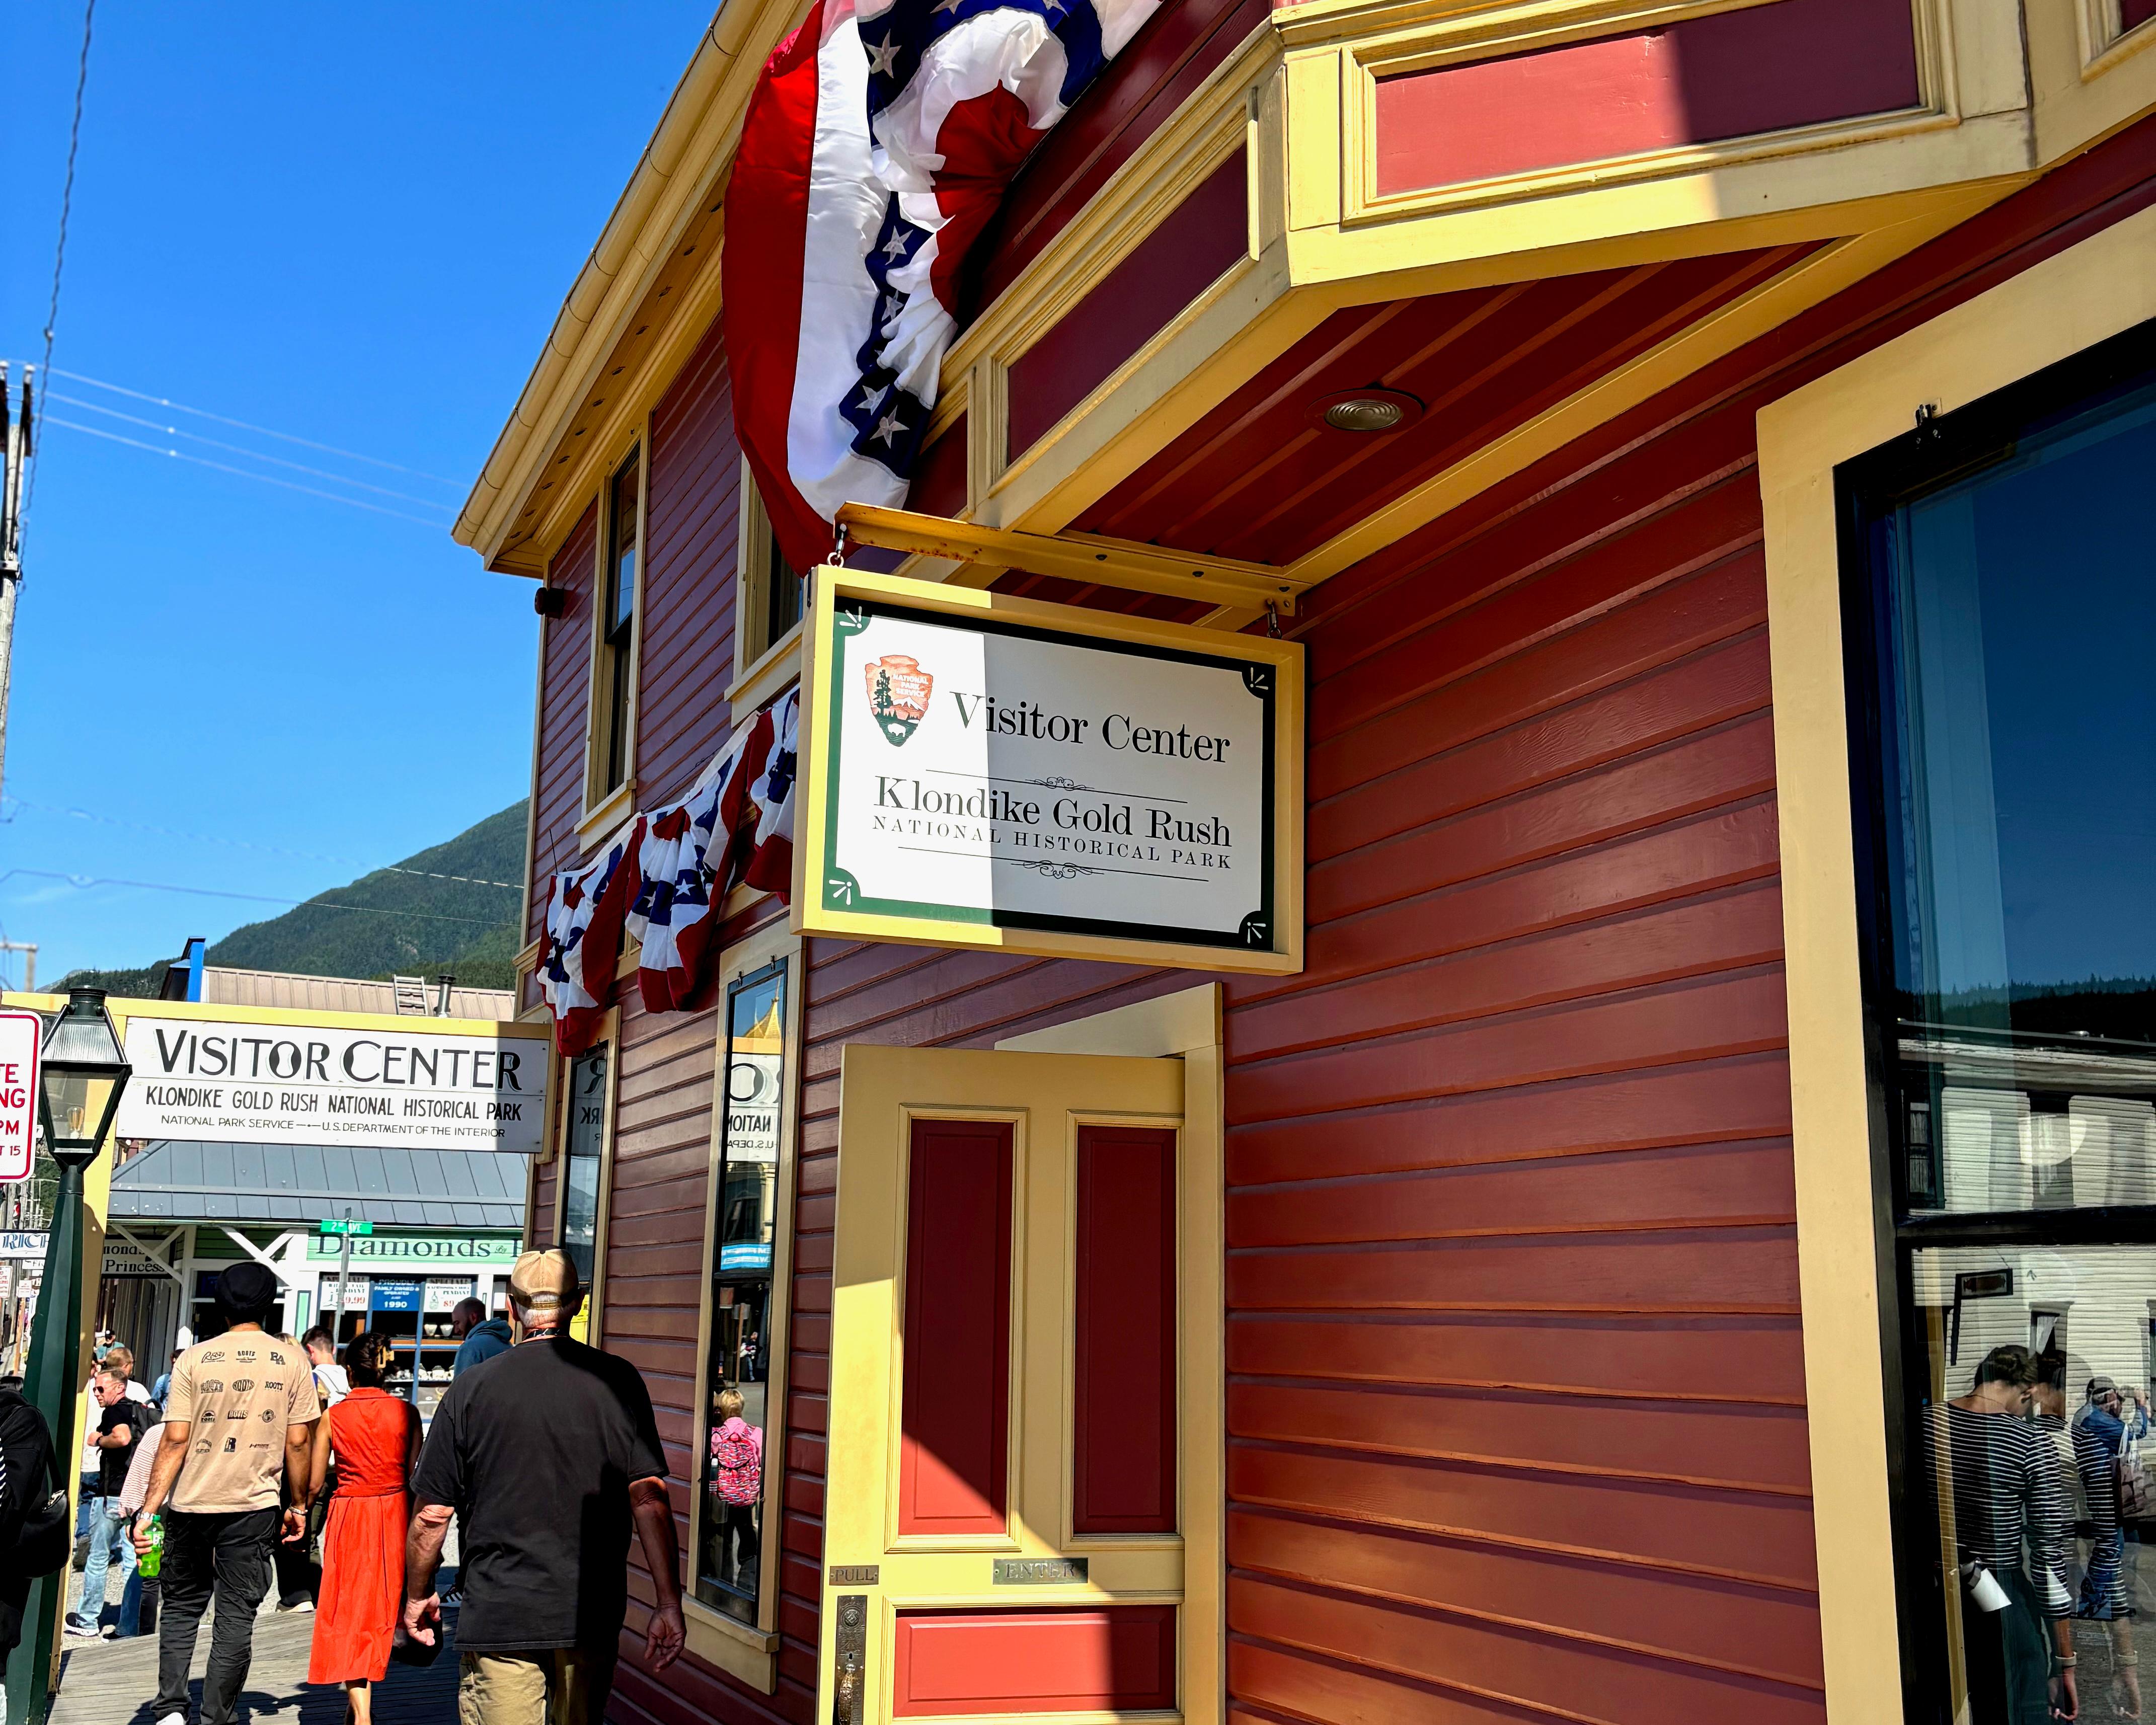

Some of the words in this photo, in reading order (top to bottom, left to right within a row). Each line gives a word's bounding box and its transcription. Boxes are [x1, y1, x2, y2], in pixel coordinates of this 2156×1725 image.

[892, 673, 929, 684] NATIONAL
[901, 682, 919, 690] PARK
[895, 687, 925, 697] SERVICE
[949, 691, 1088, 744] Visitor
[1102, 714, 1230, 763] Center
[873, 775, 1040, 824] Klondike
[1053, 798, 1133, 836] Gold
[1145, 809, 1233, 847] Rush
[872, 815, 1002, 843] NATIONAL
[1013, 831, 1160, 861] HISTORICAL
[1171, 849, 1231, 869] PARK
[155, 1029, 330, 1081] VISITOR
[342, 1040, 522, 1091] CENTER
[146, 1085, 224, 1108] KLONDIKE
[233, 1090, 273, 1110] GOLD
[280, 1092, 319, 1112] RUSH
[328, 1094, 395, 1116] NATIONAL
[403, 1098, 480, 1119] HISTORICAL
[486, 1102, 522, 1121] PARK
[161, 1115, 215, 1126] NATIONAL
[218, 1117, 246, 1127] PARK
[248, 1118, 294, 1129] SERVICE
[415, 1126, 429, 1134] OF
[430, 1126, 451, 1135] THE
[454, 1127, 505, 1138] INTERIOR
[10, 1145, 21, 1156] 15
[318, 1235, 491, 1258] Diamonds
[105, 1259, 165, 1272] Princess
[835, 1569, 874, 1582] PULL
[1006, 1562, 1075, 1579] ENTER
